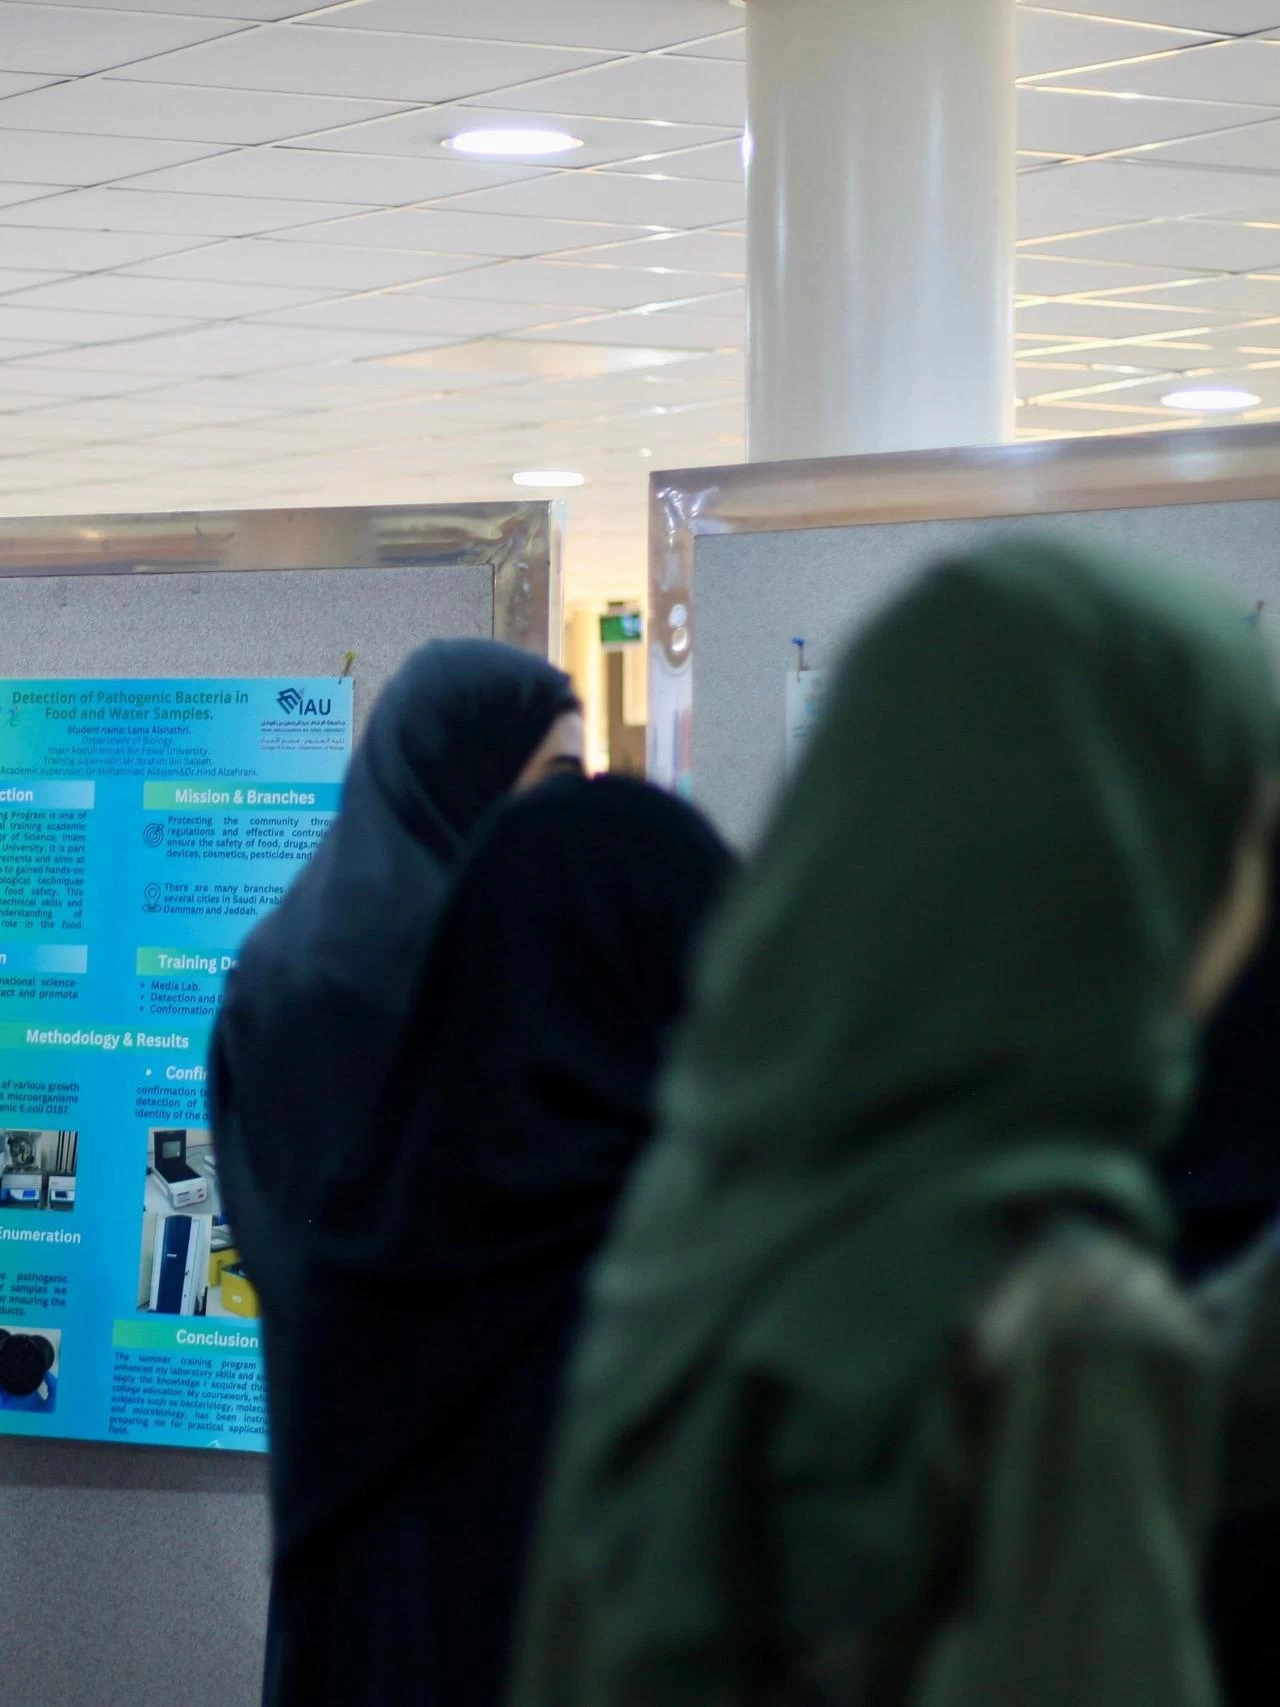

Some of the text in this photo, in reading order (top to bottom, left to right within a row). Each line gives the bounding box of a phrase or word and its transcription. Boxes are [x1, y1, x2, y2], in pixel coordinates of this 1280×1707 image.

[13, 690, 248, 707] Detection of Pathogenic Bacteria in
[299, 698, 331, 715] IAU
[45, 707, 77, 721] Food
[81, 707, 105, 721] and
[109, 707, 150, 721] Water
[67, 725, 99, 735] Student
[175, 789, 315, 804] Mission & Branches
[12, 811, 45, 820] Program
[168, 816, 212, 826] Protecting
[224, 817, 238, 825] the
[250, 817, 299, 827] community
[10, 823, 41, 832] training
[167, 827, 215, 837] regulations
[246, 829, 284, 837] effective
[199, 839, 213, 847] the
[216, 839, 243, 849] safety
[246, 840, 255, 848] of
[250, 851, 294, 860] pesticides
[16, 866, 42, 875] gained
[38, 877, 84, 886] techniques
[164, 883, 189, 892] There
[214, 885, 237, 894] many
[244, 885, 283, 893] branches
[164, 895, 194, 903] several
[196, 895, 219, 903] cities
[233, 896, 256, 904] Saudi
[163, 906, 204, 914] Dammam
[205, 906, 221, 914] and
[158, 954, 217, 974] Training
[151, 981, 178, 991] Media
[151, 993, 215, 1003] Detection and
[150, 1005, 213, 1015] Conformation
[26, 1028, 189, 1050] Methodology & Results
[14, 1080, 44, 1089] various
[137, 1085, 195, 1097] confirmation
[8, 1093, 79, 1103] microorganisms
[136, 1097, 180, 1108] detection
[135, 1109, 200, 1120] identity the
[176, 1329, 258, 1348] Conclusion
